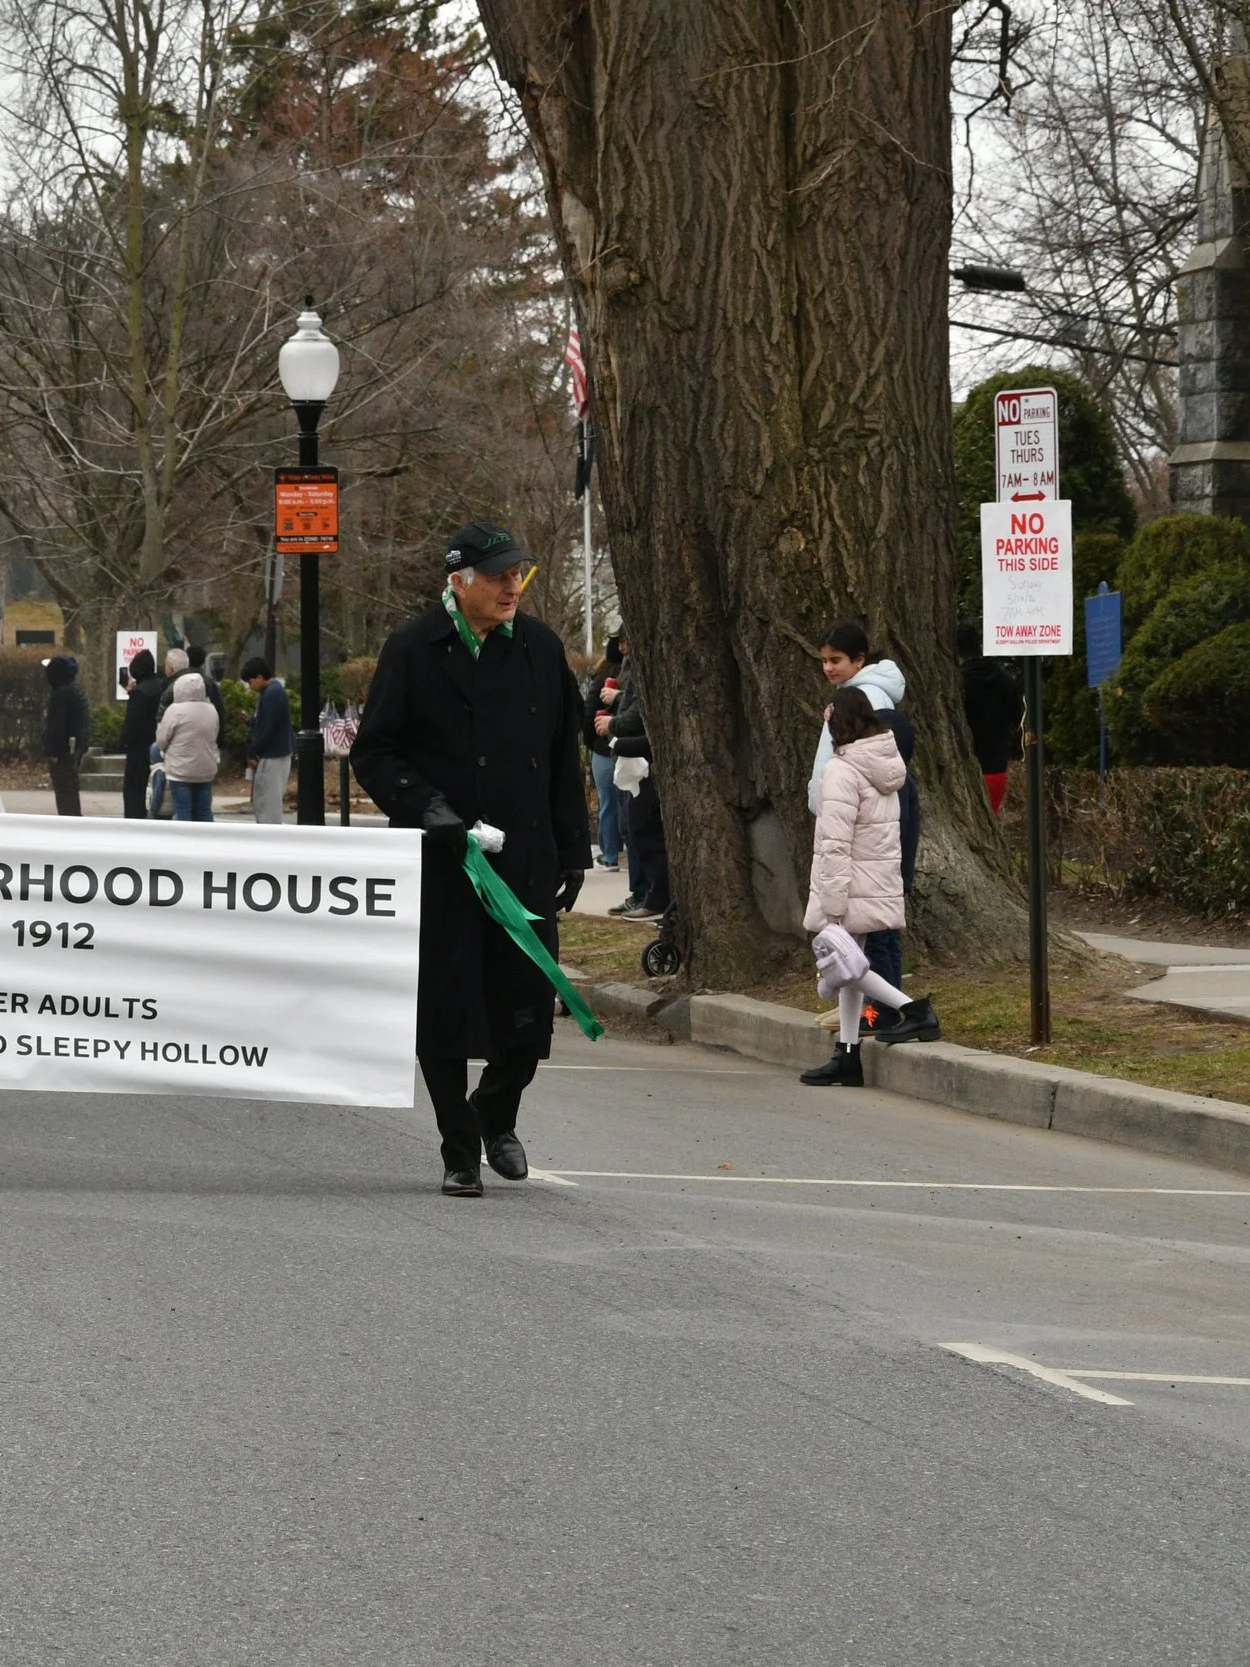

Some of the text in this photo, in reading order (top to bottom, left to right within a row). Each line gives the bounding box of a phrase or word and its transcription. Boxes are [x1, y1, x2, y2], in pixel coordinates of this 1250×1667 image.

[998, 399, 1050, 422] NO PARKING
[1014, 430, 1040, 446] TUES
[1010, 448, 1044, 463] THURS
[1011, 513, 1044, 535] NO
[996, 537, 1059, 556] PARKING
[998, 557, 1059, 572] THIS SIDE
[995, 625, 1061, 637] TOW AWAY ZONE
[130, 637, 144, 647] NO
[203, 870, 396, 917] HOUSE
[12, 919, 95, 950] 1912
[37, 994, 158, 1020] ADULTS
[16, 1034, 132, 1060] SLEEPY
[140, 1041, 269, 1067] HOLLOW
